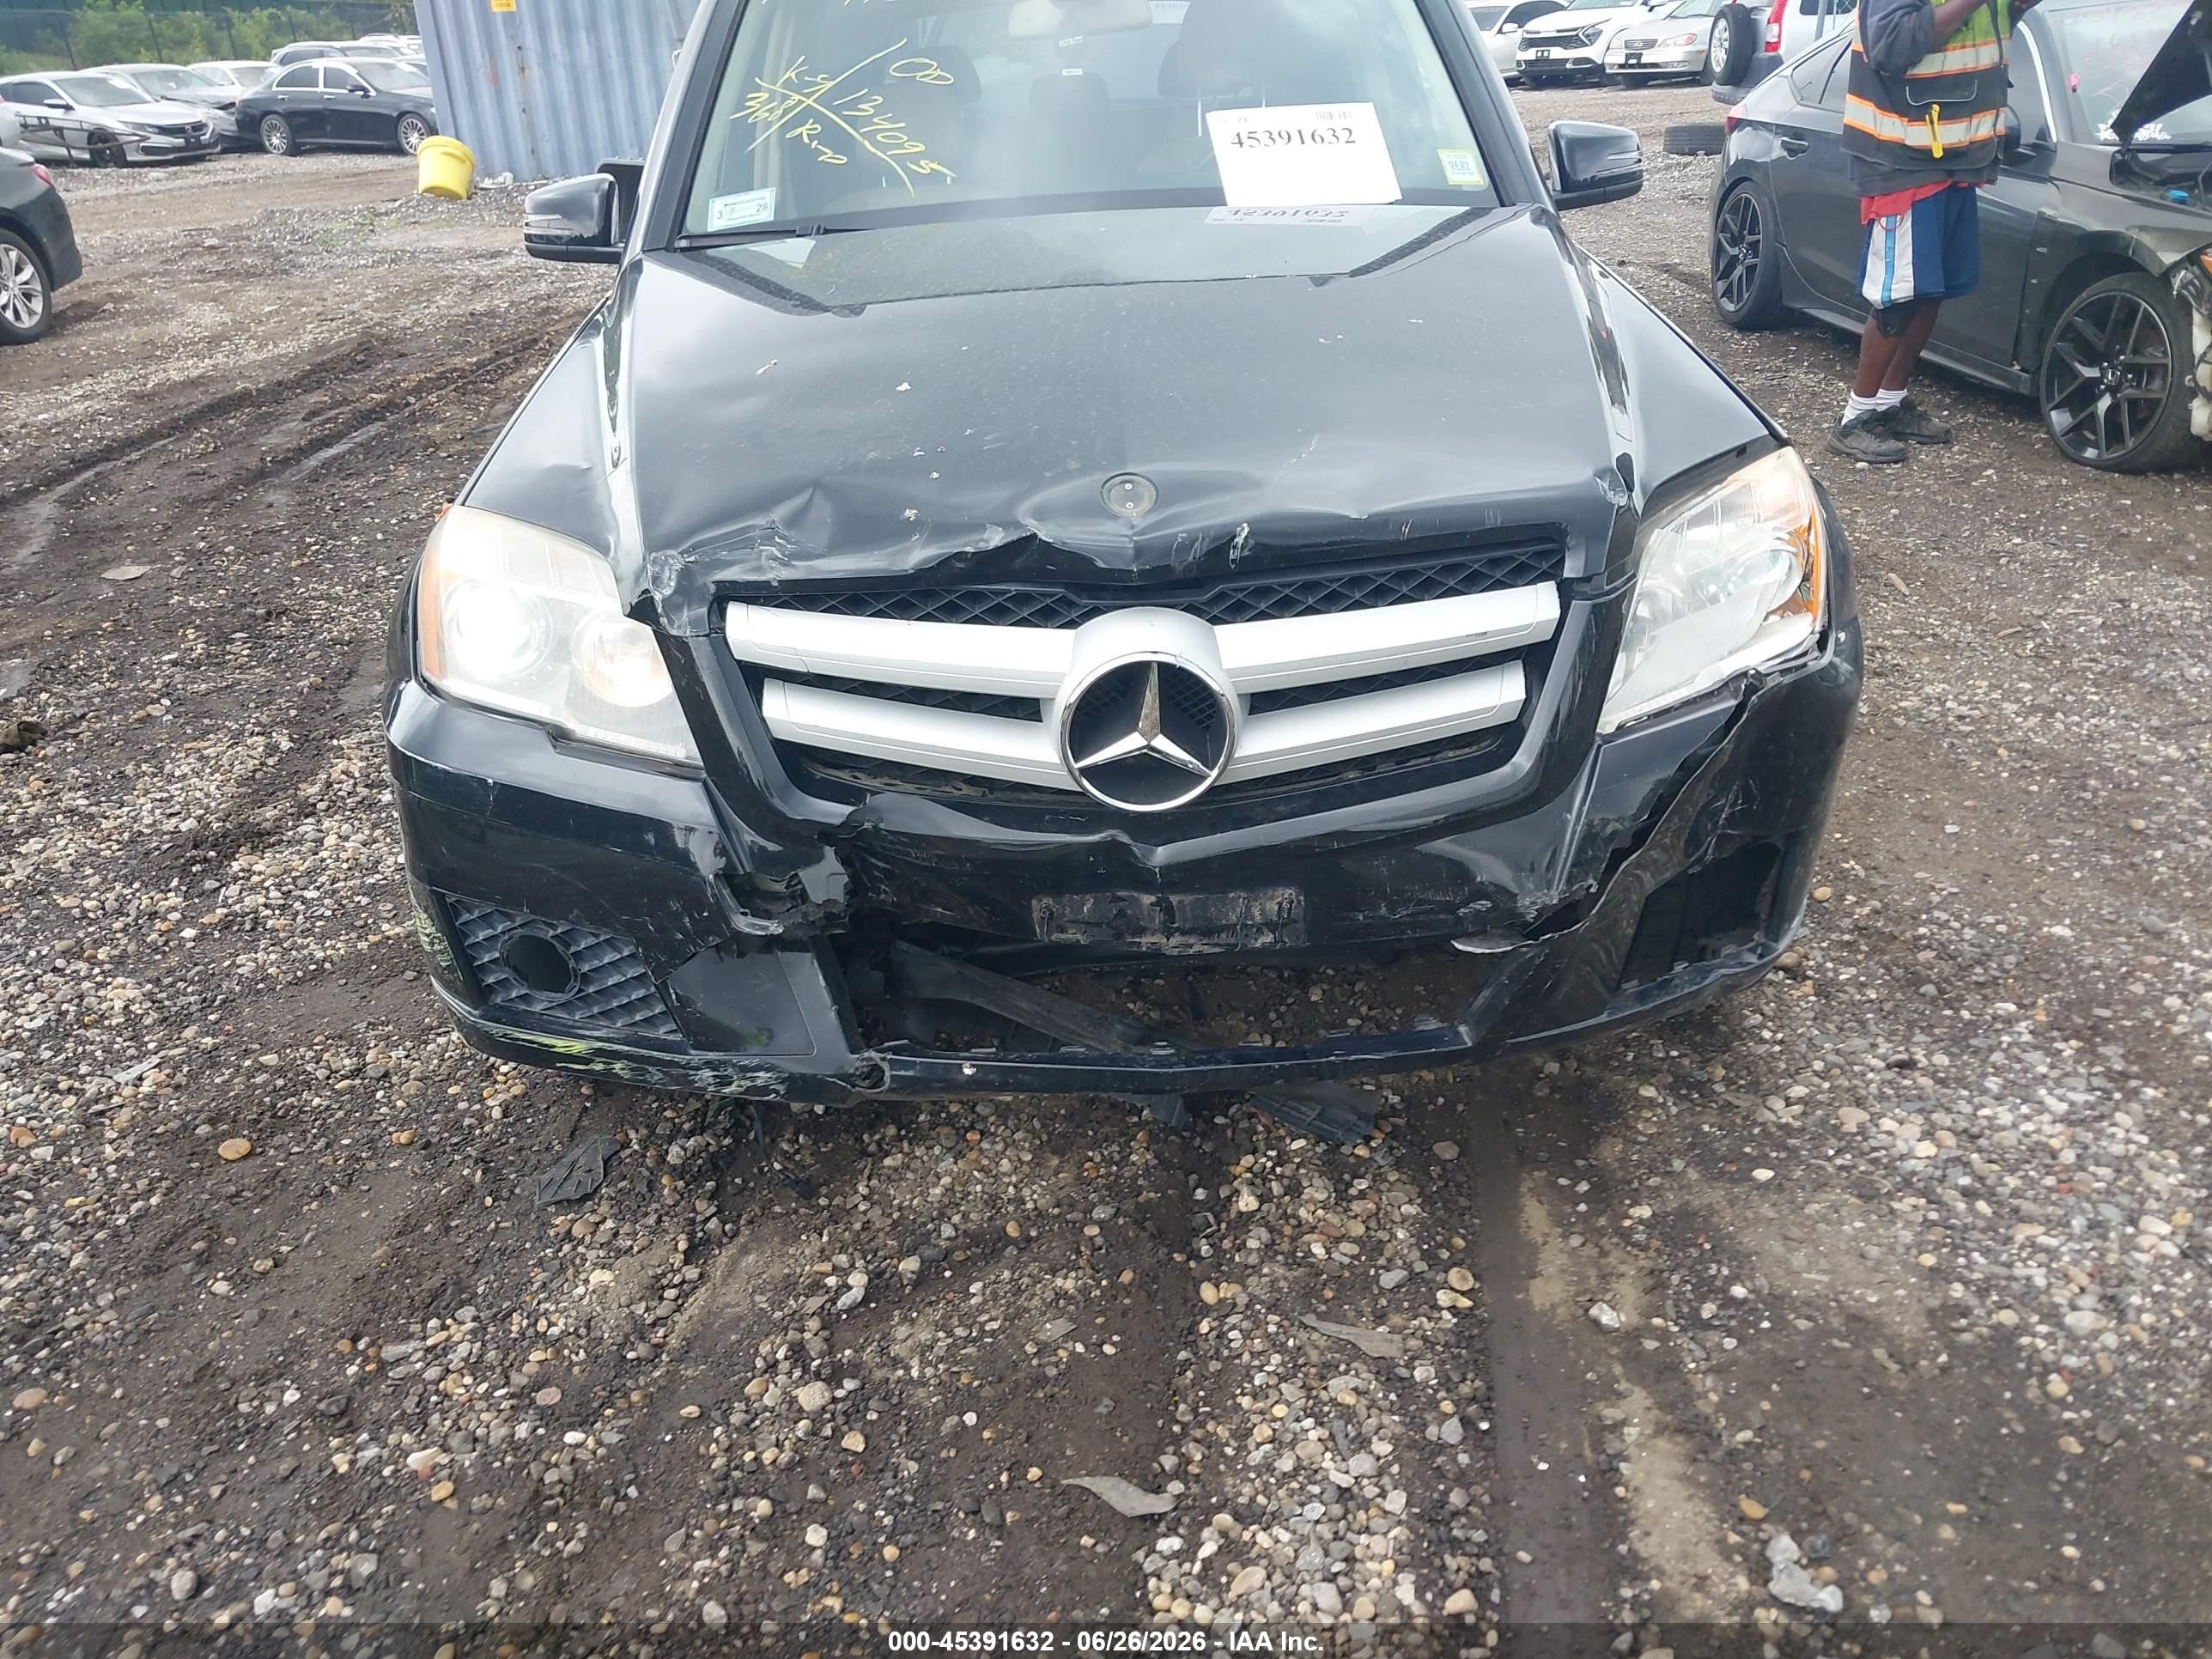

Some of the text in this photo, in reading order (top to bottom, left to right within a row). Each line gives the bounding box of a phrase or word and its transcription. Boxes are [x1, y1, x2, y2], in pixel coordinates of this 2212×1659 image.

[1231, 127, 1357, 149] 45391632
[716, 210, 724, 220] 3
[756, 203, 769, 213] 28
